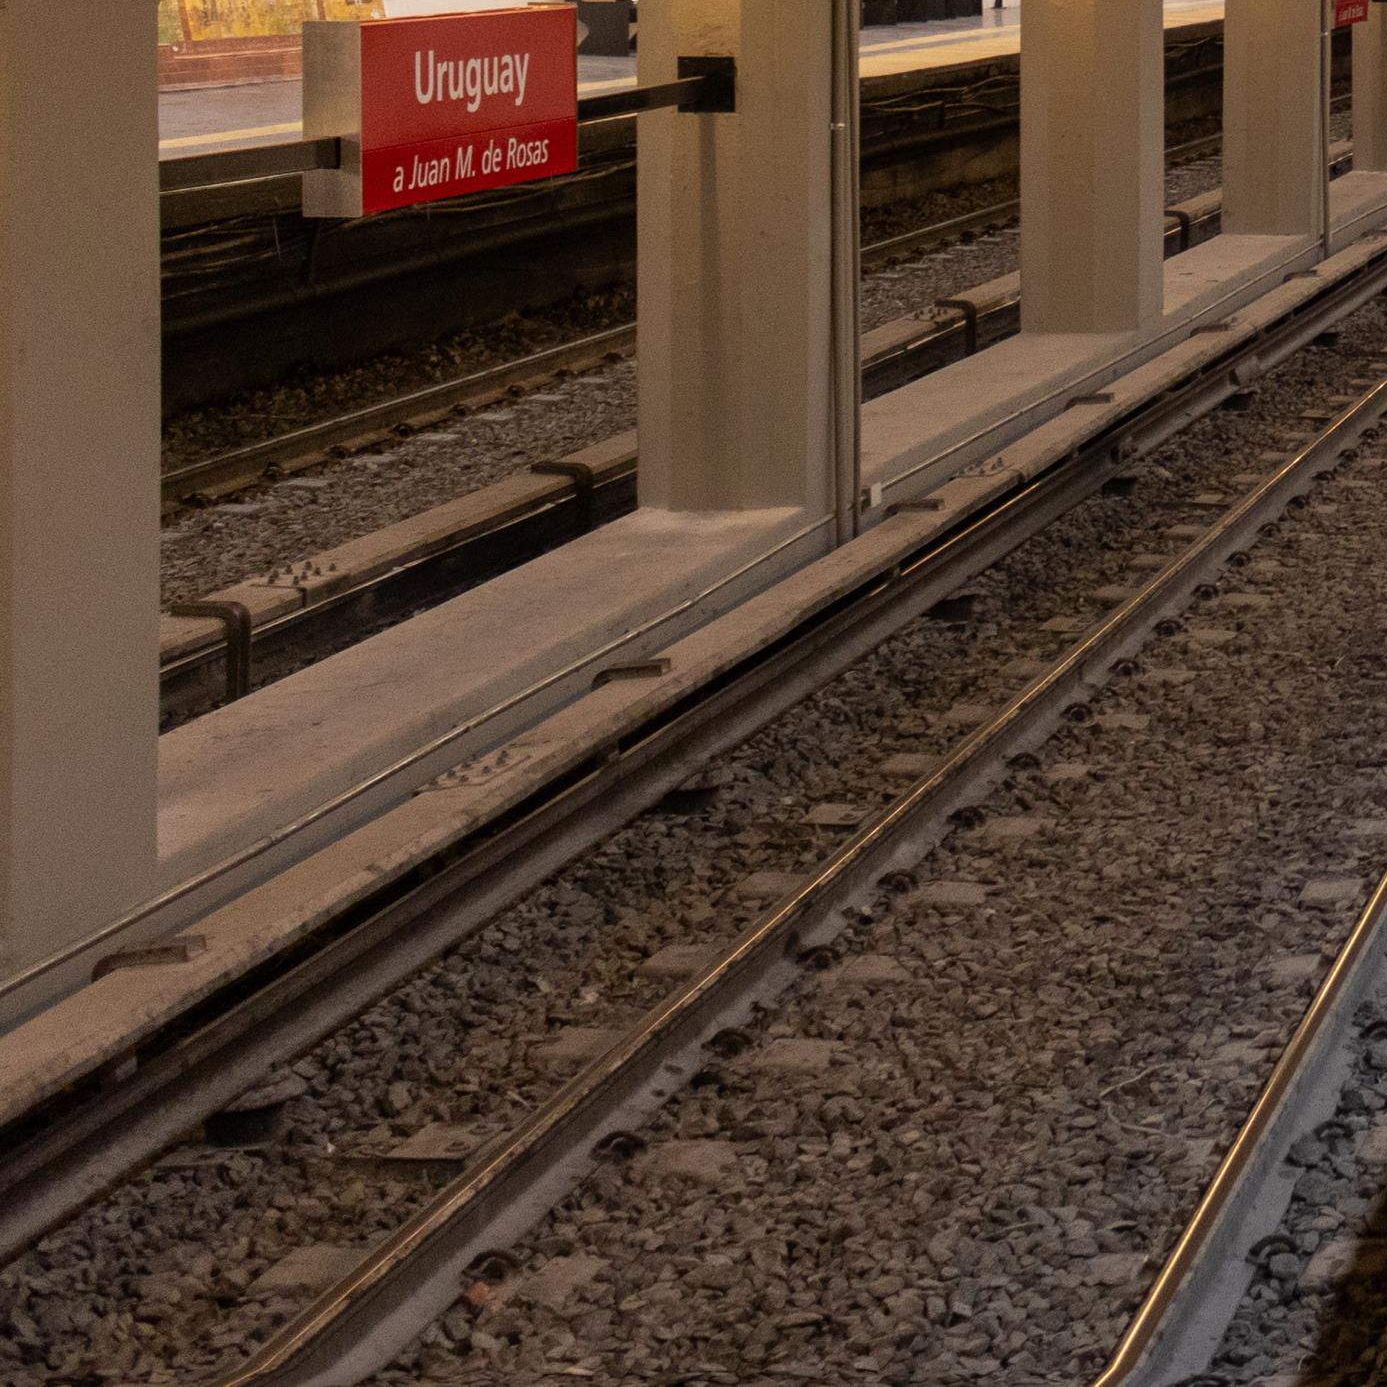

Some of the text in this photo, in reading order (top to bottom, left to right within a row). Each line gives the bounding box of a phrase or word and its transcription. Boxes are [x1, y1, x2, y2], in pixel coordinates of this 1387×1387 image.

[415, 50, 530, 113] Uruguay
[393, 137, 550, 193] a Juan M. de Rosas
